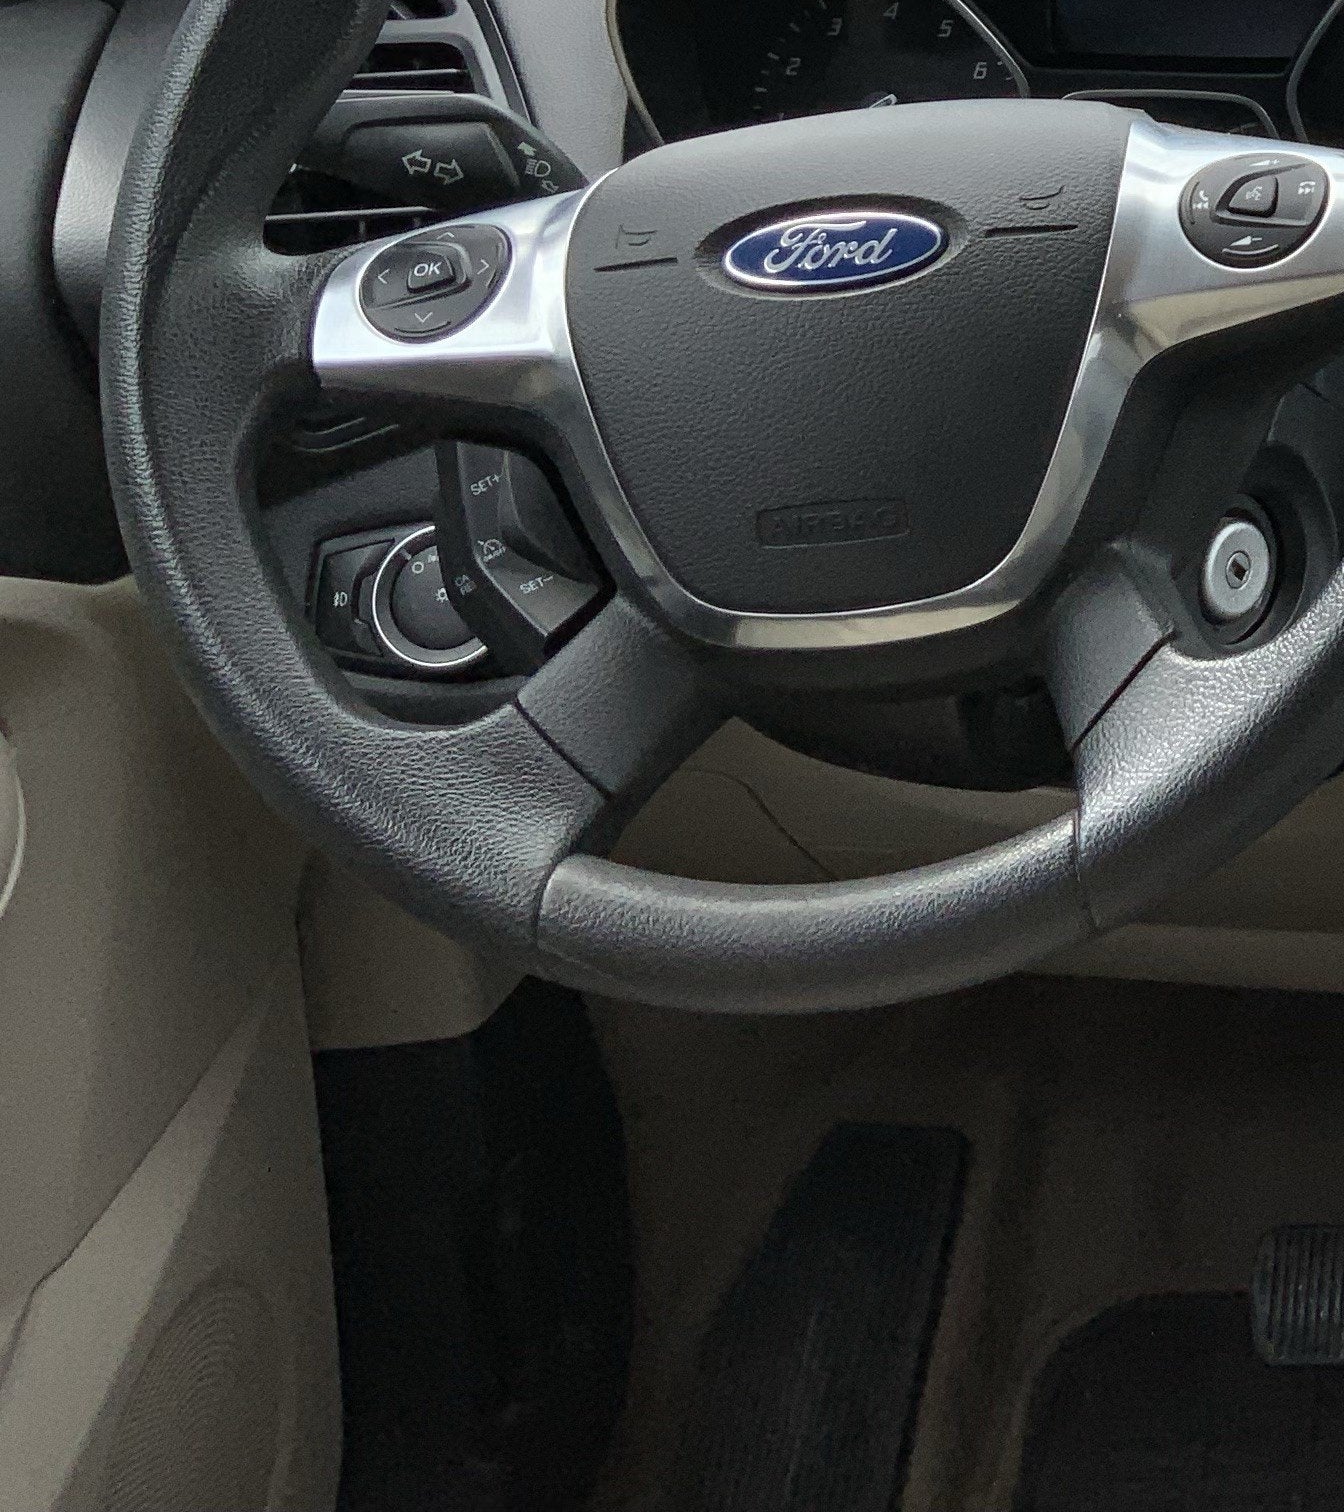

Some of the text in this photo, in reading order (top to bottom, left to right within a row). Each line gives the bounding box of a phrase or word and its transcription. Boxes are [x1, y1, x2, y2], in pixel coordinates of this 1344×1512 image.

[883, 2, 899, 19] 4
[826, 17, 843, 36] 3
[937, 19, 954, 39] 5
[785, 57, 802, 76] 2
[973, 62, 987, 80] 6
[763, 220, 899, 274] Ford
[413, 261, 443, 277] OK
[470, 474, 500, 496] SET+
[519, 575, 554, 594] SET-
